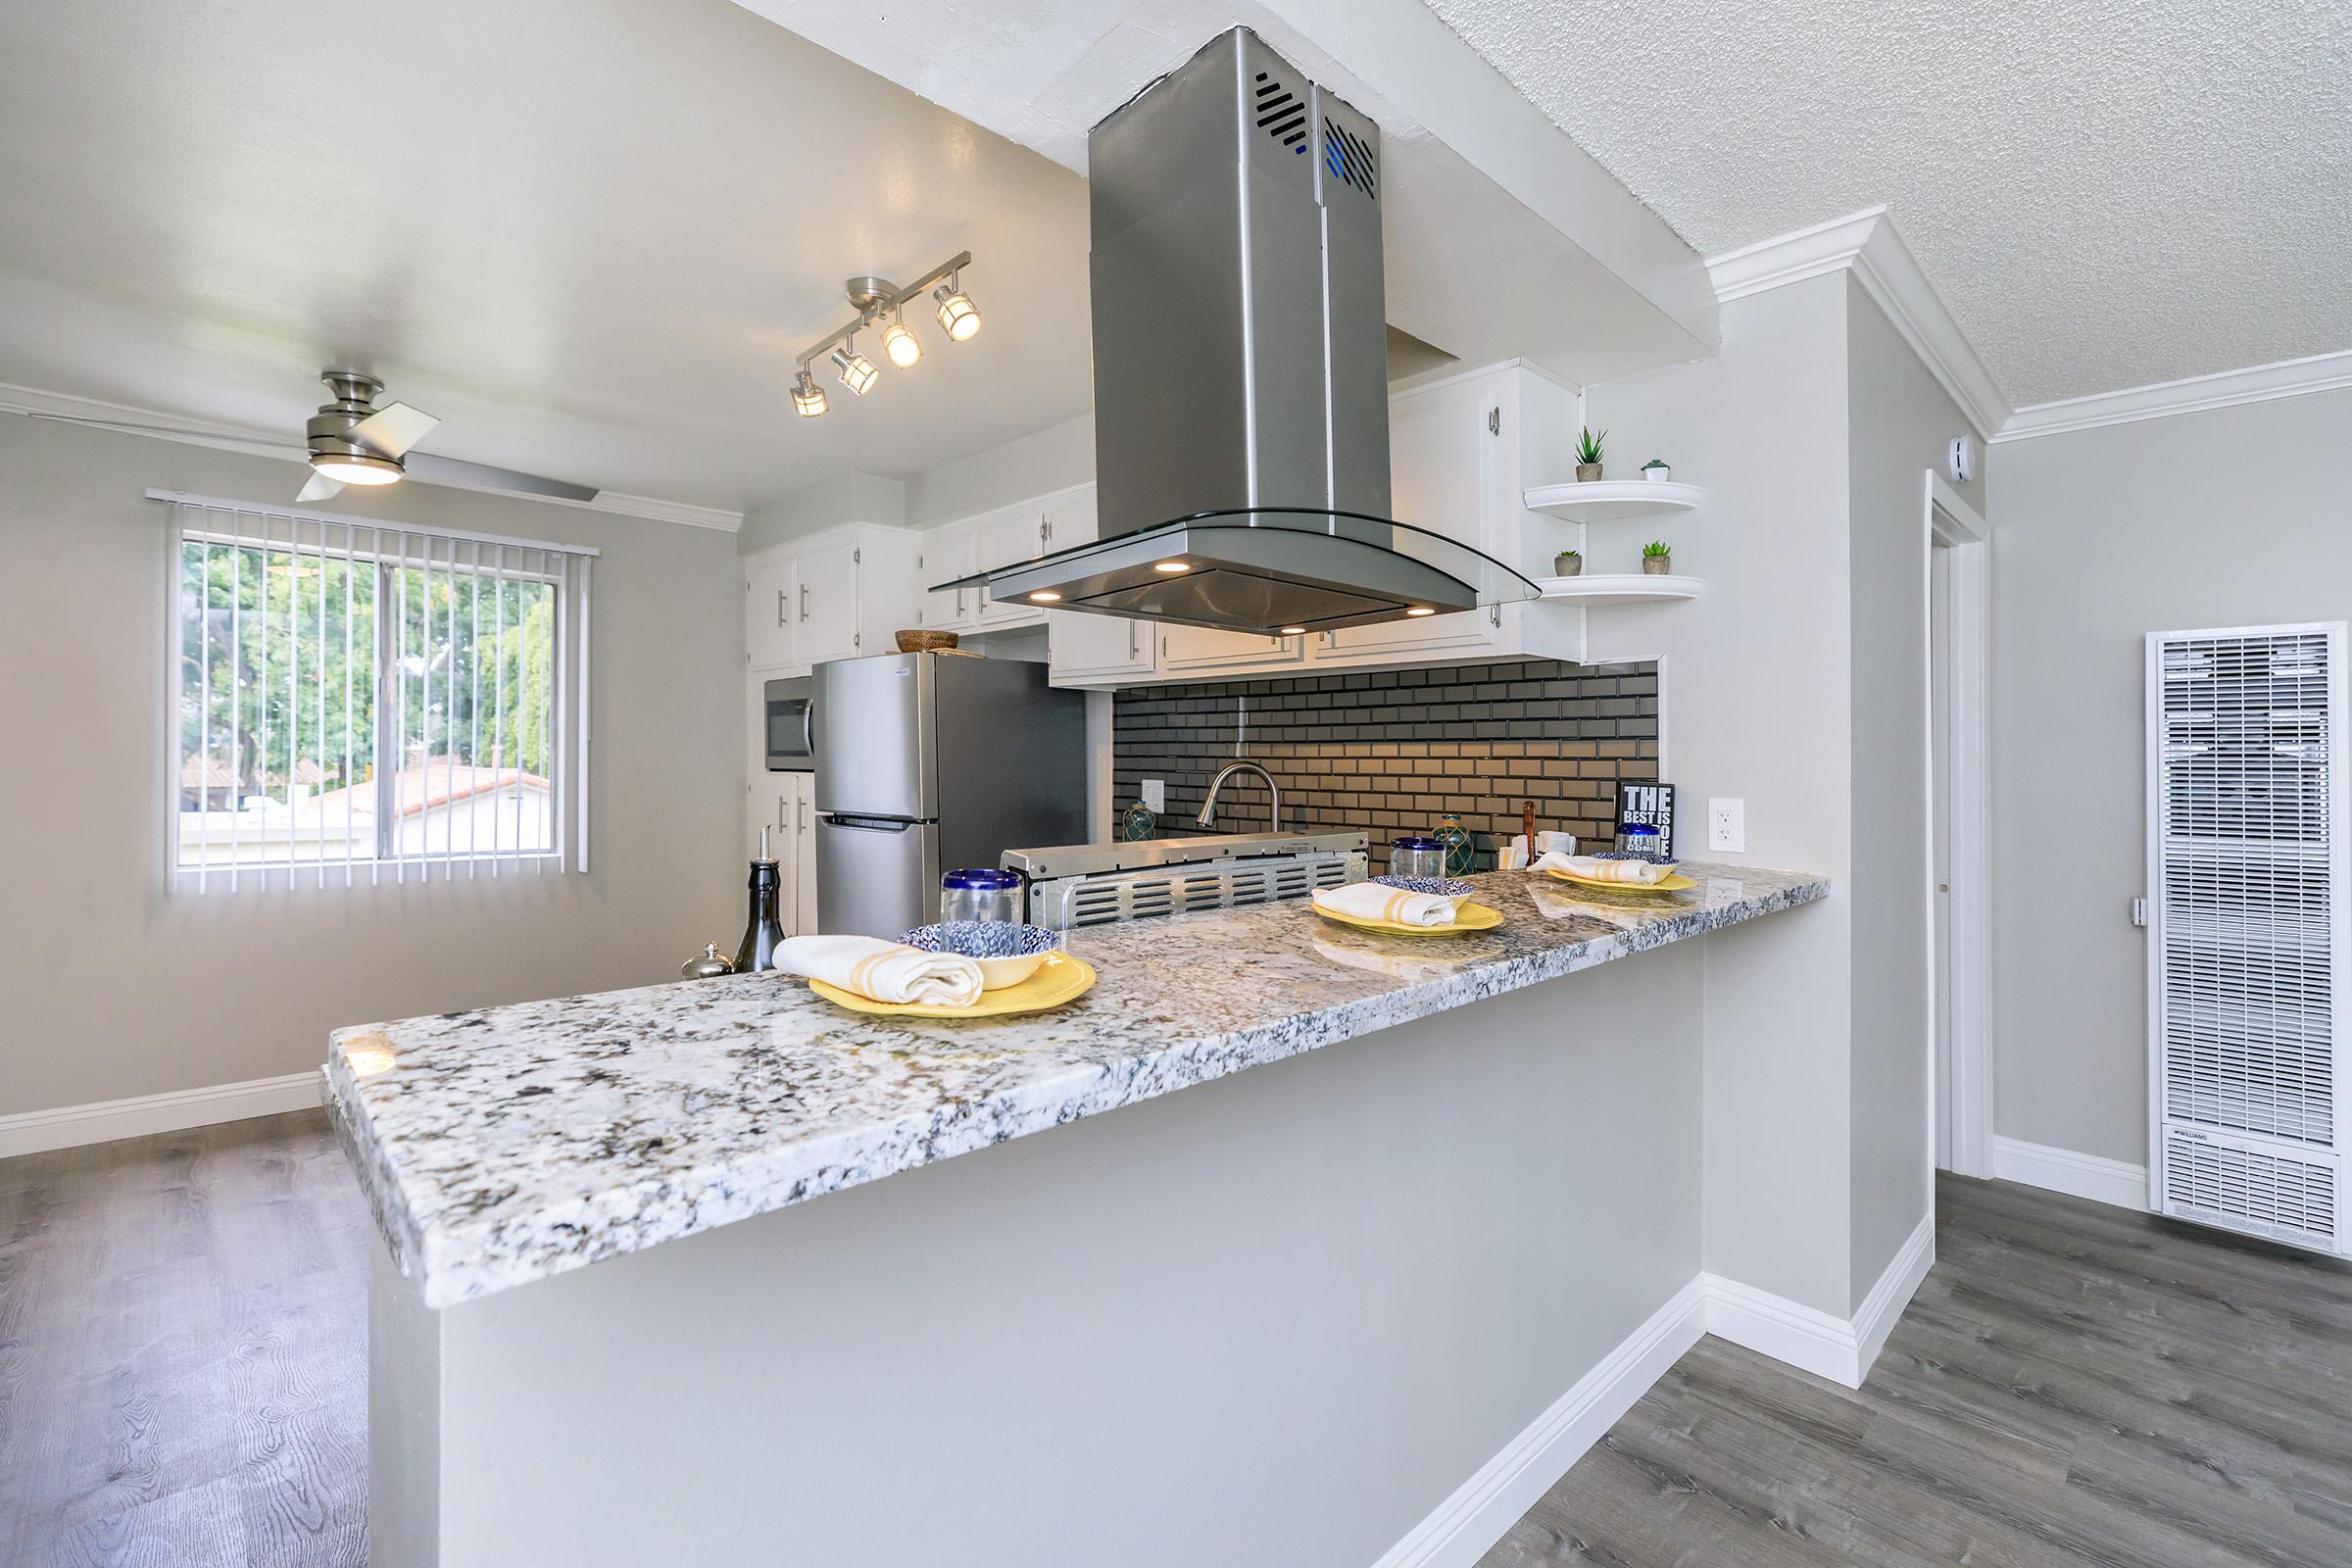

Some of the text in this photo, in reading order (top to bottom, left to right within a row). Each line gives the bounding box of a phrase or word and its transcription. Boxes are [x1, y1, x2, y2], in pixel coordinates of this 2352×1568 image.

[1624, 786, 1671, 811] THE
[1624, 810, 1670, 824] BEST IS
[2180, 1131, 2207, 1140] WILLIAMS
